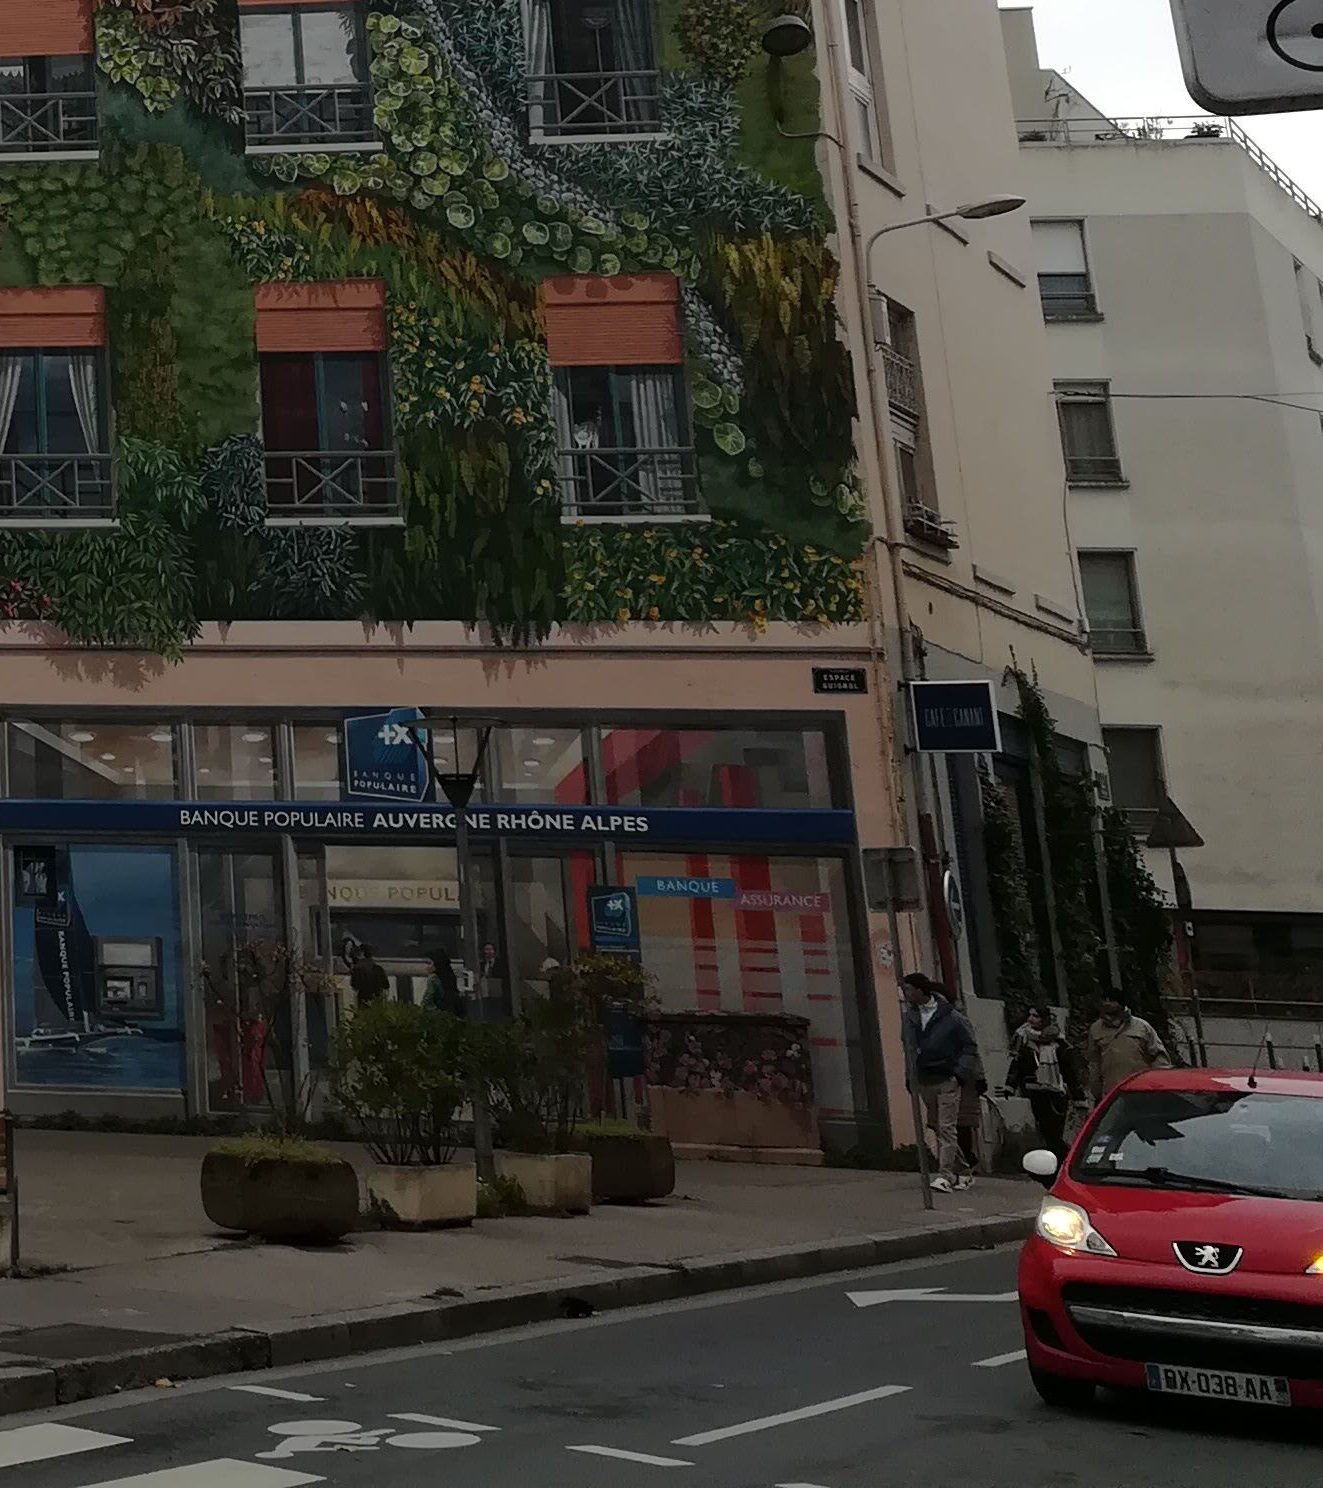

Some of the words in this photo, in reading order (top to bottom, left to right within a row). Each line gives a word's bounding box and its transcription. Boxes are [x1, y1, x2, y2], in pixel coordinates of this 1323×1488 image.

[822, 682, 860, 690] GUIGNOL
[353, 770, 417, 782] BANQUE
[353, 779, 417, 794] POPULAIRE
[180, 809, 259, 828] BANQUE
[264, 811, 365, 829] POPULAIRE
[496, 810, 576, 831] RHÔNE
[581, 815, 649, 833] ALPES
[656, 879, 720, 894] BANQUE
[739, 894, 822, 908] ASSURANCE
[57, 930, 69, 969] BANQUE
[62, 971, 75, 1023] POPULAIRE
